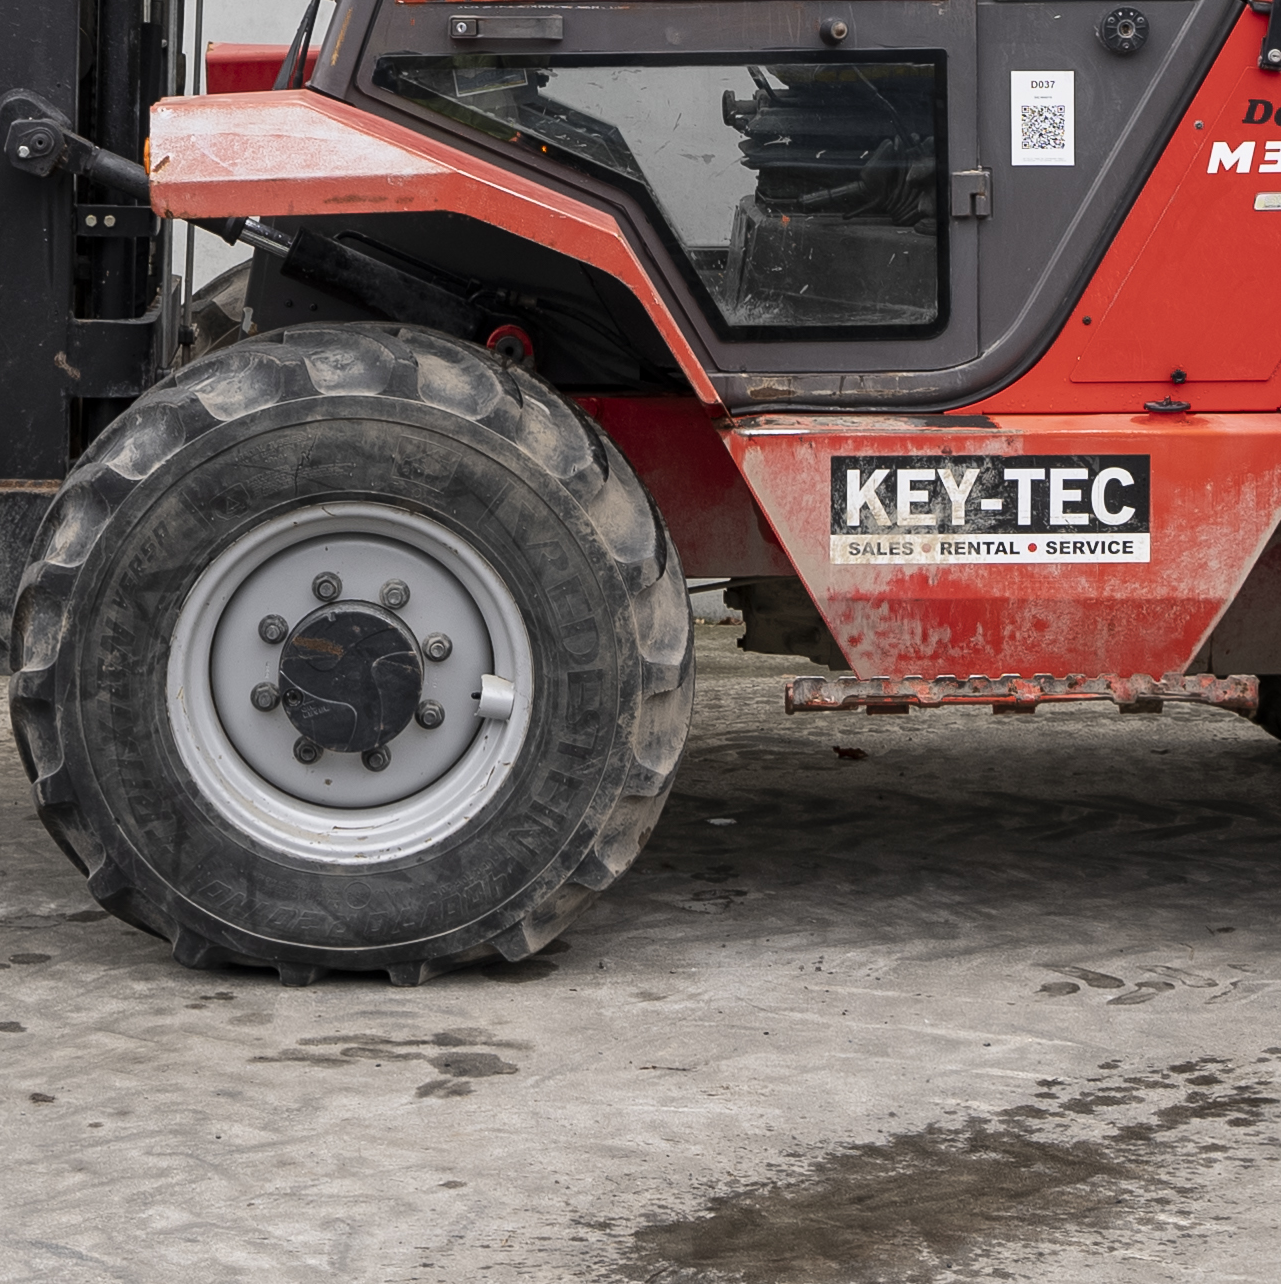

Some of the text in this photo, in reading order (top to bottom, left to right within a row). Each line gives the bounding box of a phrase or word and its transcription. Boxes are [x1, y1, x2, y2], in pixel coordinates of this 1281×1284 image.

[1031, 80, 1055, 89] D037
[846, 467, 1136, 527] KEY-TEC
[848, 540, 1134, 556] SALES RENTAL SERVICE
[495, 496, 608, 872] VREDESTEIN
